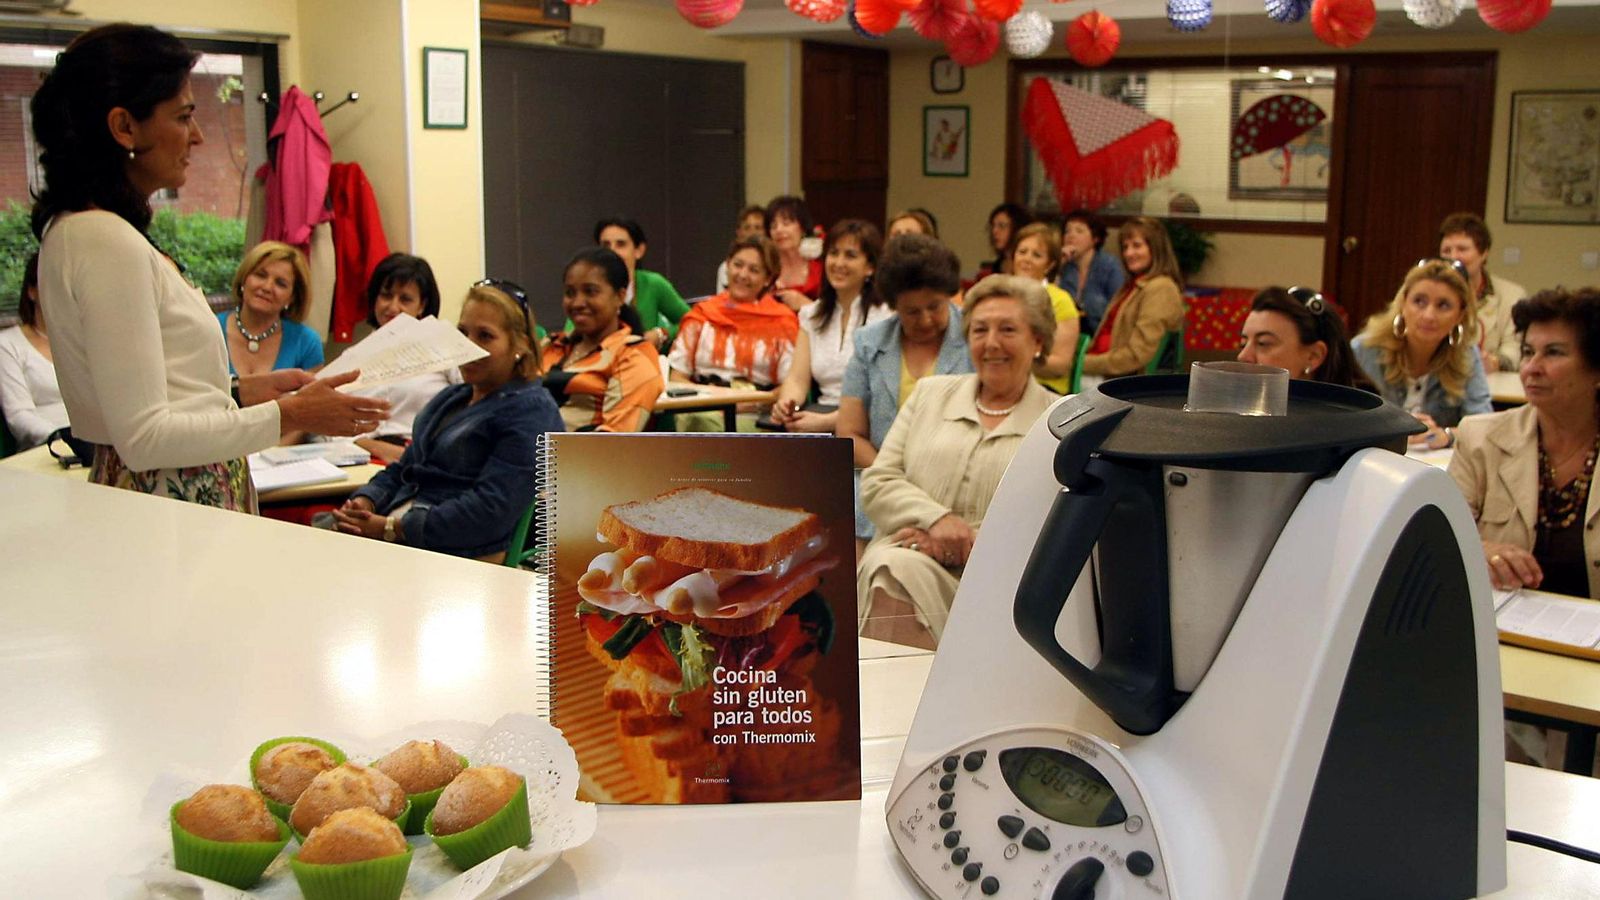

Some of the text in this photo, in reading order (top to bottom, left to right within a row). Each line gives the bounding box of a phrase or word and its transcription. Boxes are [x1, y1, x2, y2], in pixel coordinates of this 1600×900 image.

[712, 666, 777, 684] Cocina
[713, 686, 807, 708] sin gluten
[713, 706, 812, 729] para todos
[713, 730, 816, 745] con Thermomix
